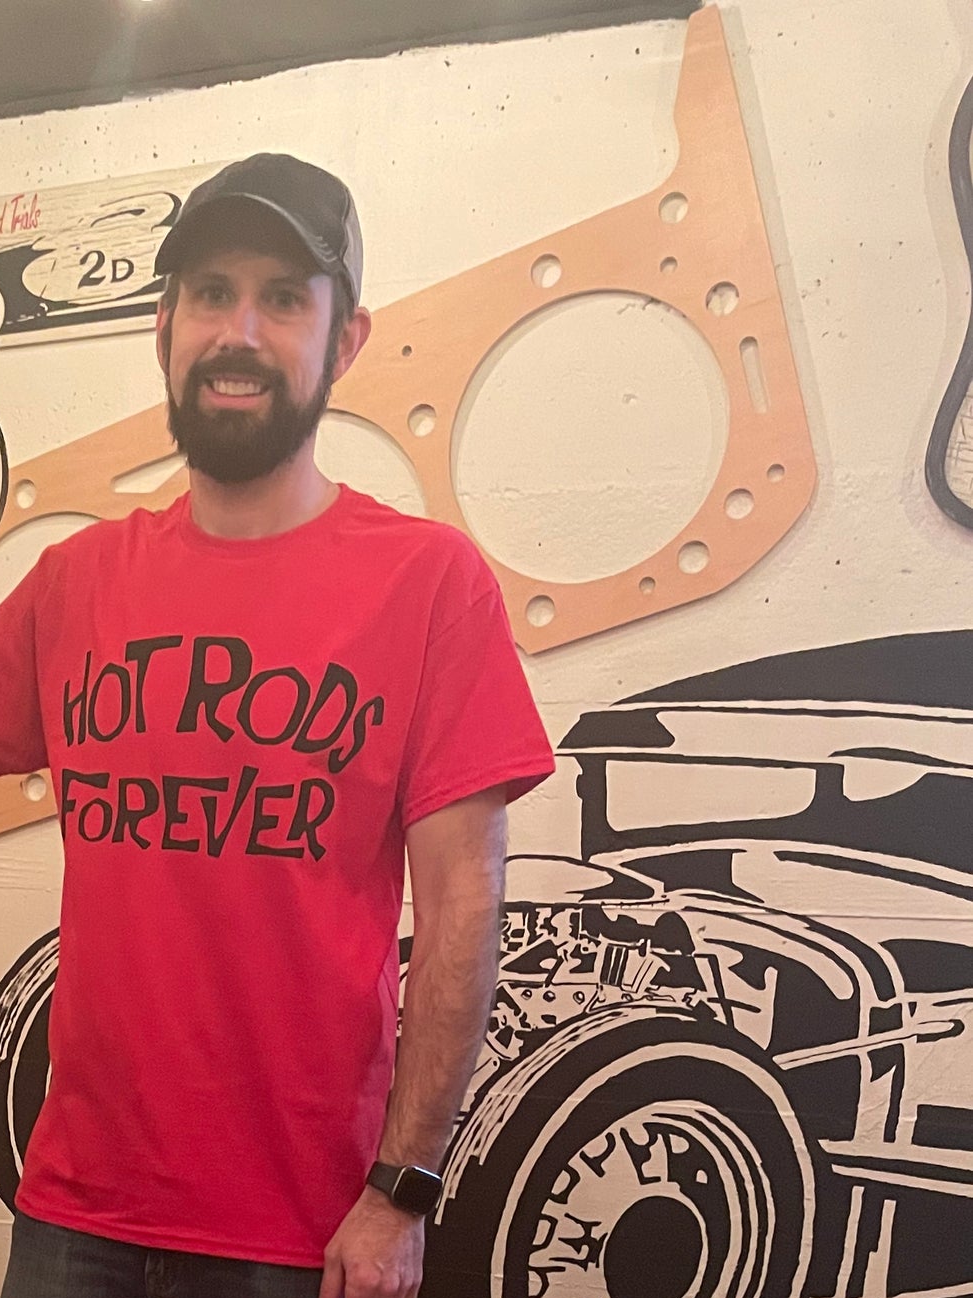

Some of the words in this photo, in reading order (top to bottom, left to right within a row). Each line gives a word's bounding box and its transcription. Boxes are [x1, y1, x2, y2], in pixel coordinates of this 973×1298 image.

[11, 192, 41, 234] Trials
[78, 250, 135, 290] 2D
[62, 635, 184, 748] HOT
[176, 635, 385, 774] RODS
[61, 766, 336, 863] FOREVER
